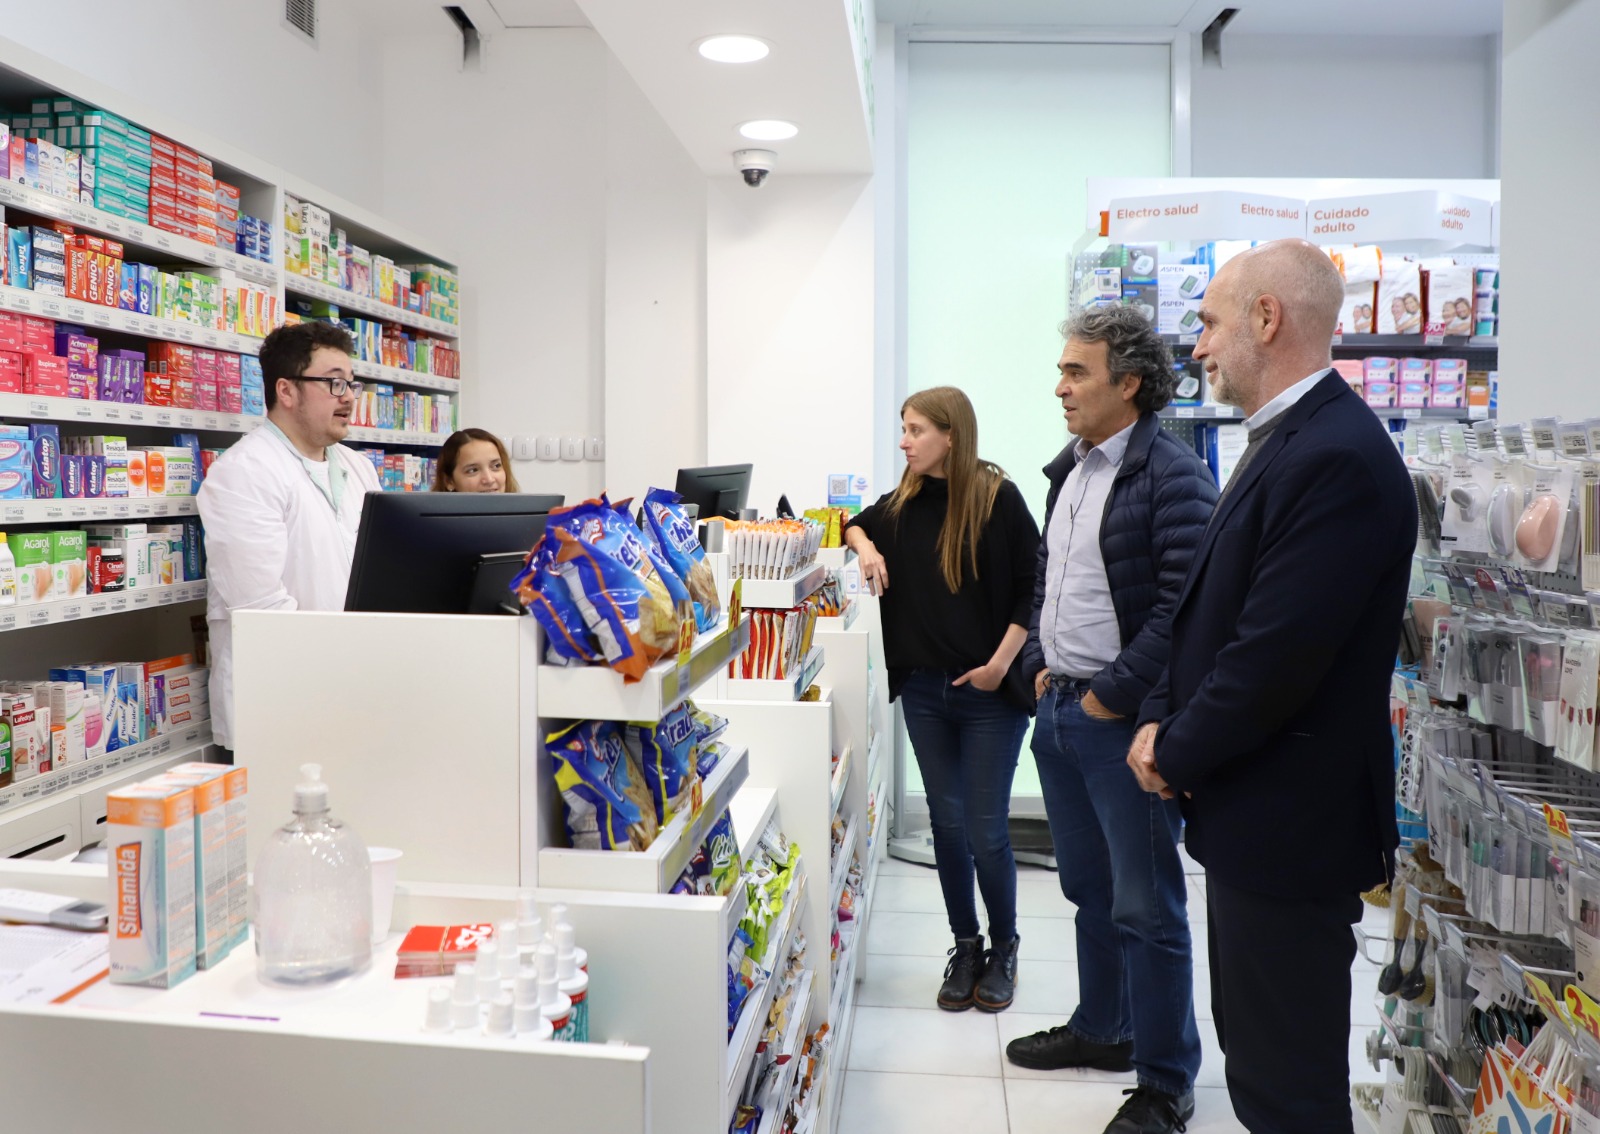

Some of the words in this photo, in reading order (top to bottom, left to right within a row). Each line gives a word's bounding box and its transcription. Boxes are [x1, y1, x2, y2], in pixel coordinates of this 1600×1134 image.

[1117, 207, 1161, 219] Electro
[1164, 203, 1199, 216] salud
[1241, 203, 1274, 217] Electro
[1276, 207, 1299, 220] salud
[1314, 207, 1369, 221] Cuidado
[1313, 221, 1355, 234] adulto
[1441, 218, 1464, 230] adulto
[89, 259, 98, 301] GENIOL
[105, 264, 115, 305] GENIOL
[42, 437, 51, 480] Aziatop
[90, 460, 98, 495] Aziatop
[23, 537, 50, 549] Agarol
[58, 534, 83, 547] Agarol
[118, 848, 137, 936] Sinamida
